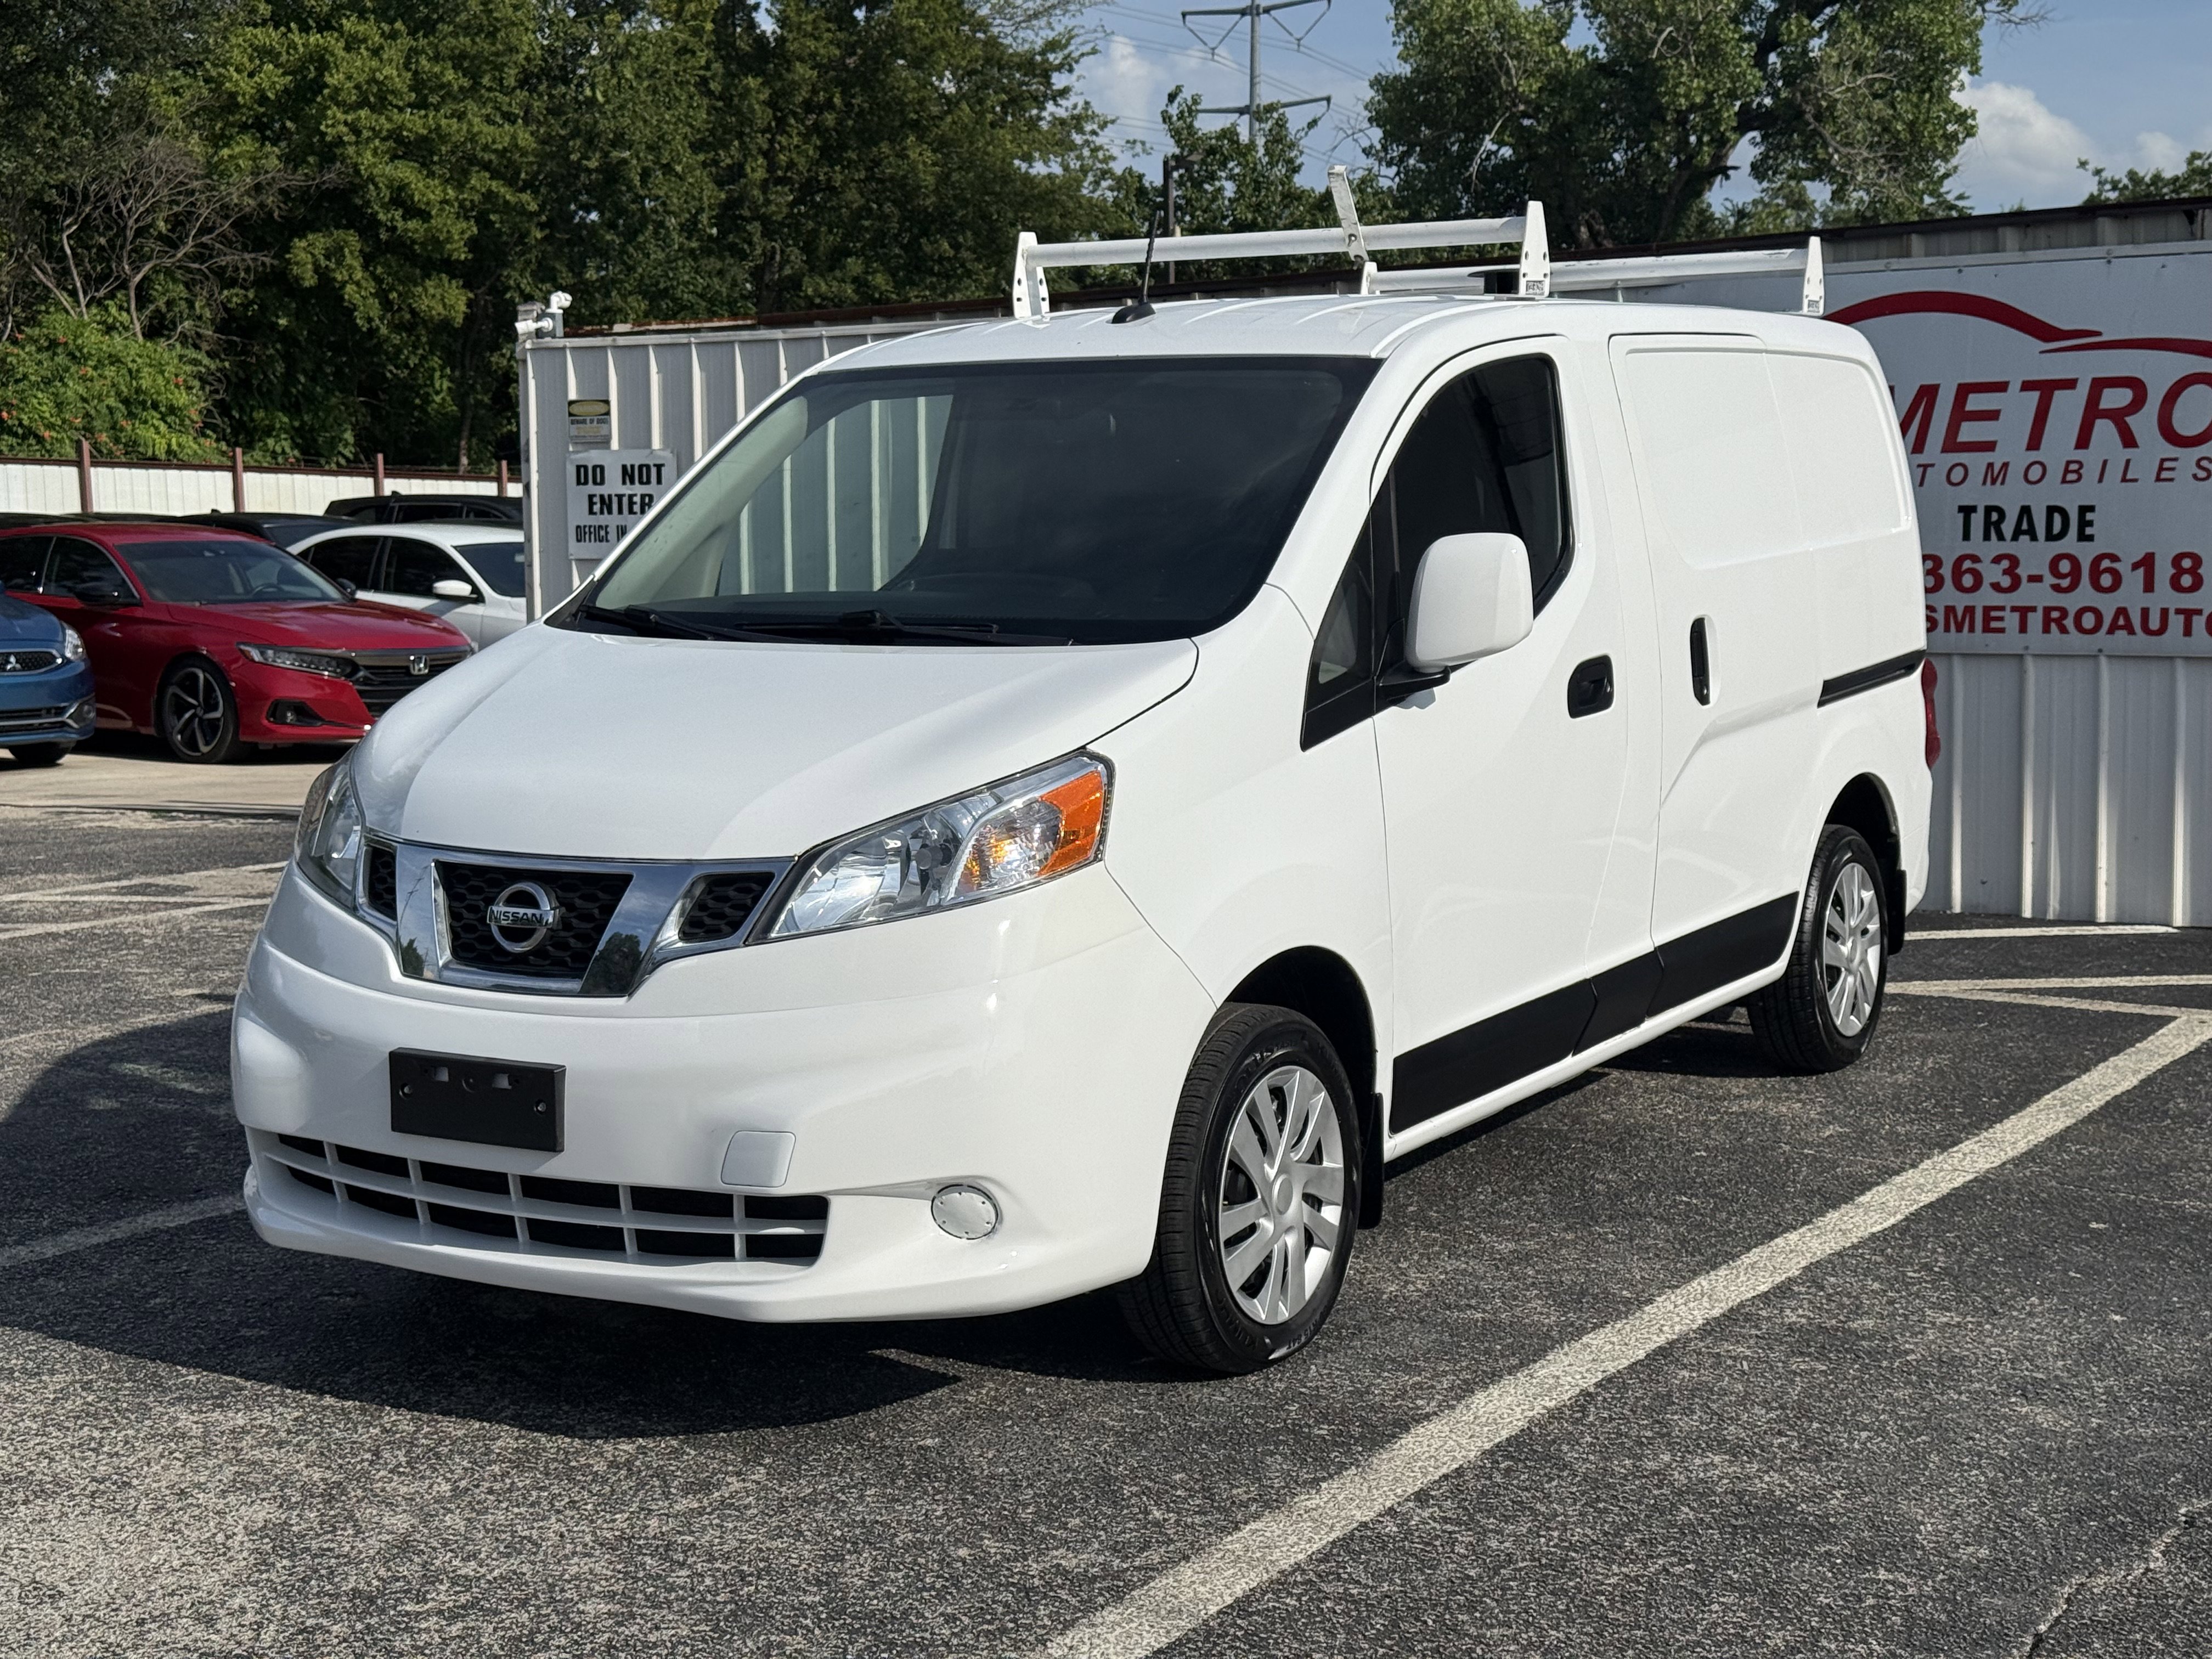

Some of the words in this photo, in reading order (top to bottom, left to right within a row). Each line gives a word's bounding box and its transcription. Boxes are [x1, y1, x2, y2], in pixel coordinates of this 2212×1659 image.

[576, 464, 606, 486] DO
[622, 464, 665, 486] NOT
[588, 493, 654, 515] ENTER
[575, 524, 610, 543] OFFICE
[1957, 505, 2096, 542] TRADE
[1926, 603, 2212, 637] SMETROAUT
[490, 909, 543, 923] NISSAN
